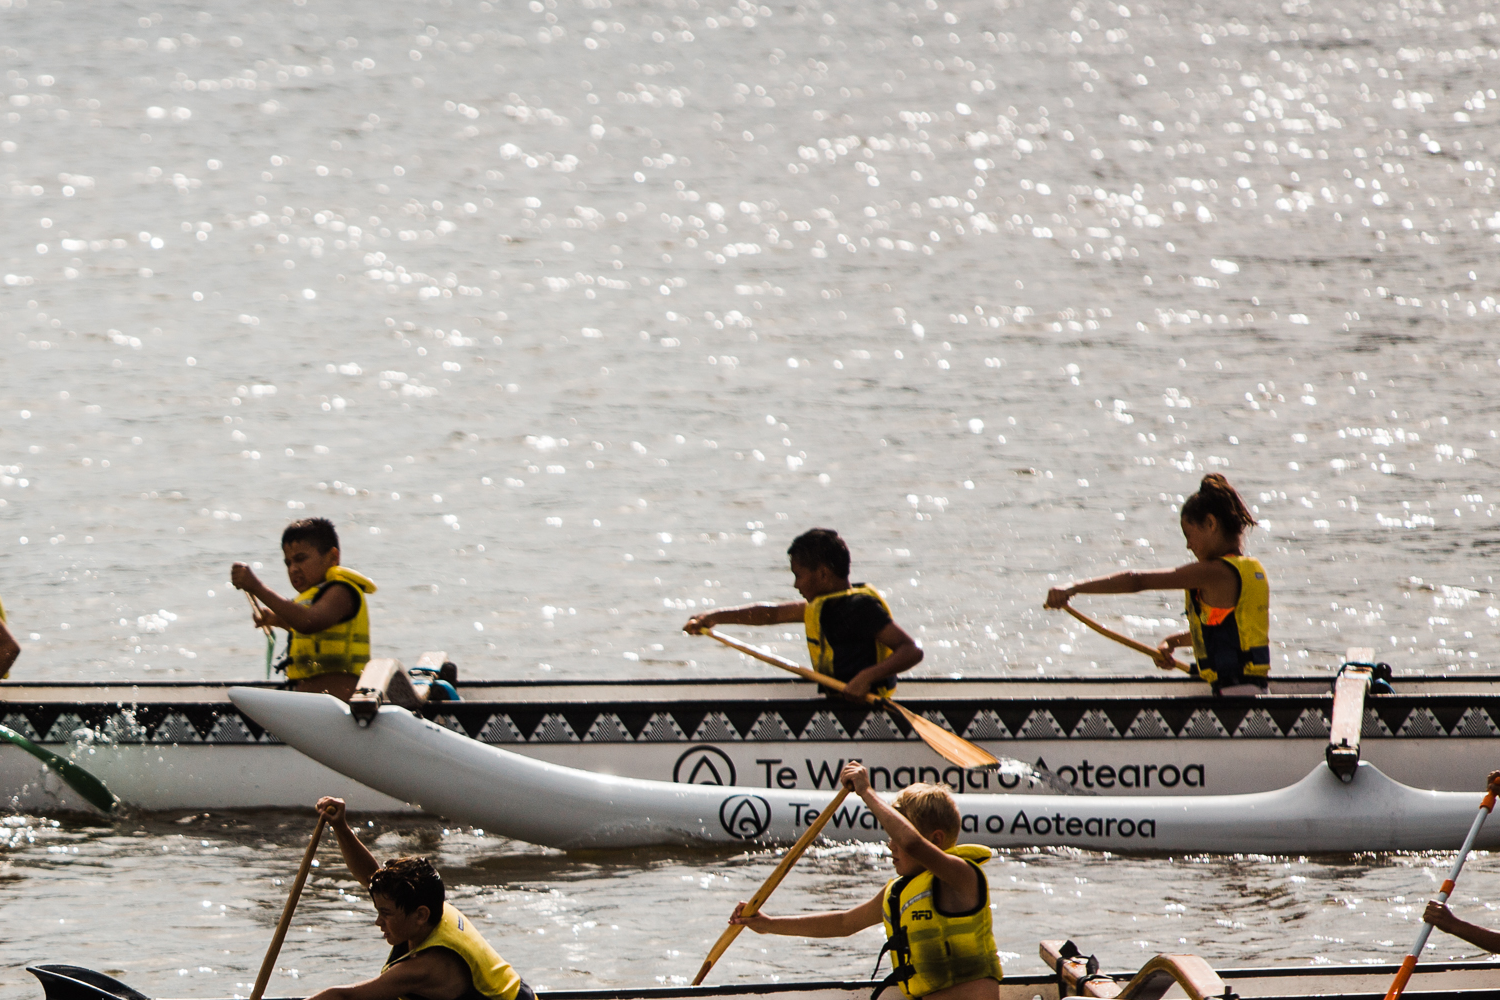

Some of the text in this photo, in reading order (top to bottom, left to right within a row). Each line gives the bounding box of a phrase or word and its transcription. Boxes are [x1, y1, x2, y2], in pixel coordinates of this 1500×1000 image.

[756, 758, 798, 789] Te
[805, 757, 989, 794] Wnanga
[788, 802, 821, 829] Te
[985, 814, 1005, 834] o
[1009, 809, 1157, 838] Aotearoa
[911, 910, 933, 921] RFD
